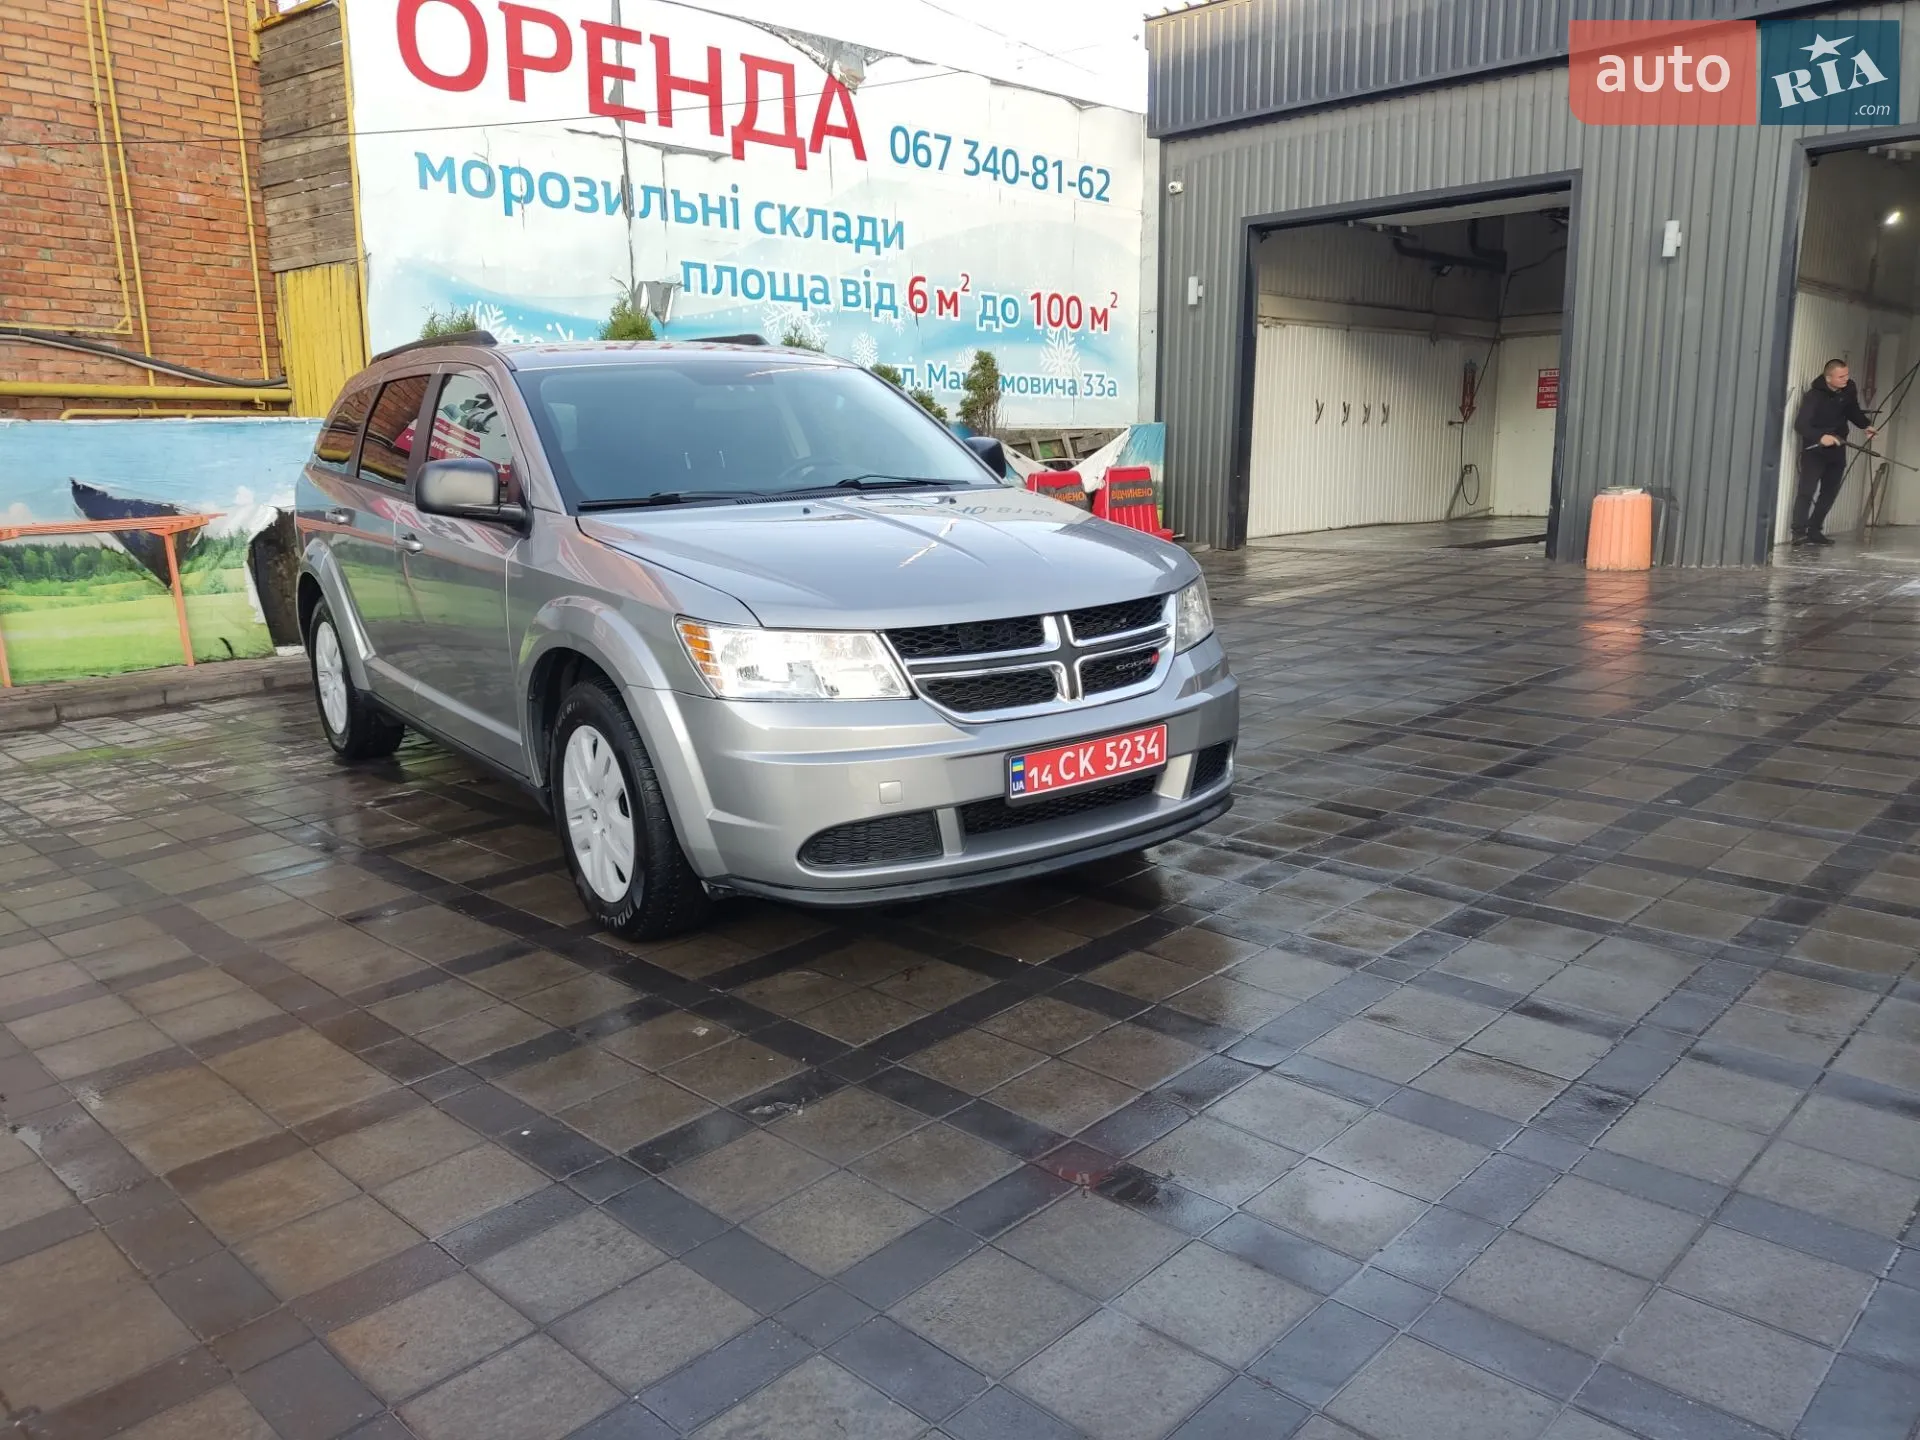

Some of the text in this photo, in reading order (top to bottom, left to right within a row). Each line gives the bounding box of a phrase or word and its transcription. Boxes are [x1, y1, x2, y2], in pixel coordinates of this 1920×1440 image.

[396, 0, 867, 170] ОРЕНДА
[889, 124, 1111, 202] 067 340-81-62
[414, 150, 905, 256] морозильні склади
[680, 260, 831, 311] площа
[840, 268, 899, 319] від
[907, 275, 928, 314] 6
[976, 289, 1020, 332] до
[1029, 291, 1083, 330] 100
[1083, 373, 1118, 397] 33а
[1012, 781, 1024, 792] UA
[1028, 731, 1160, 789] 14 CK 5234
